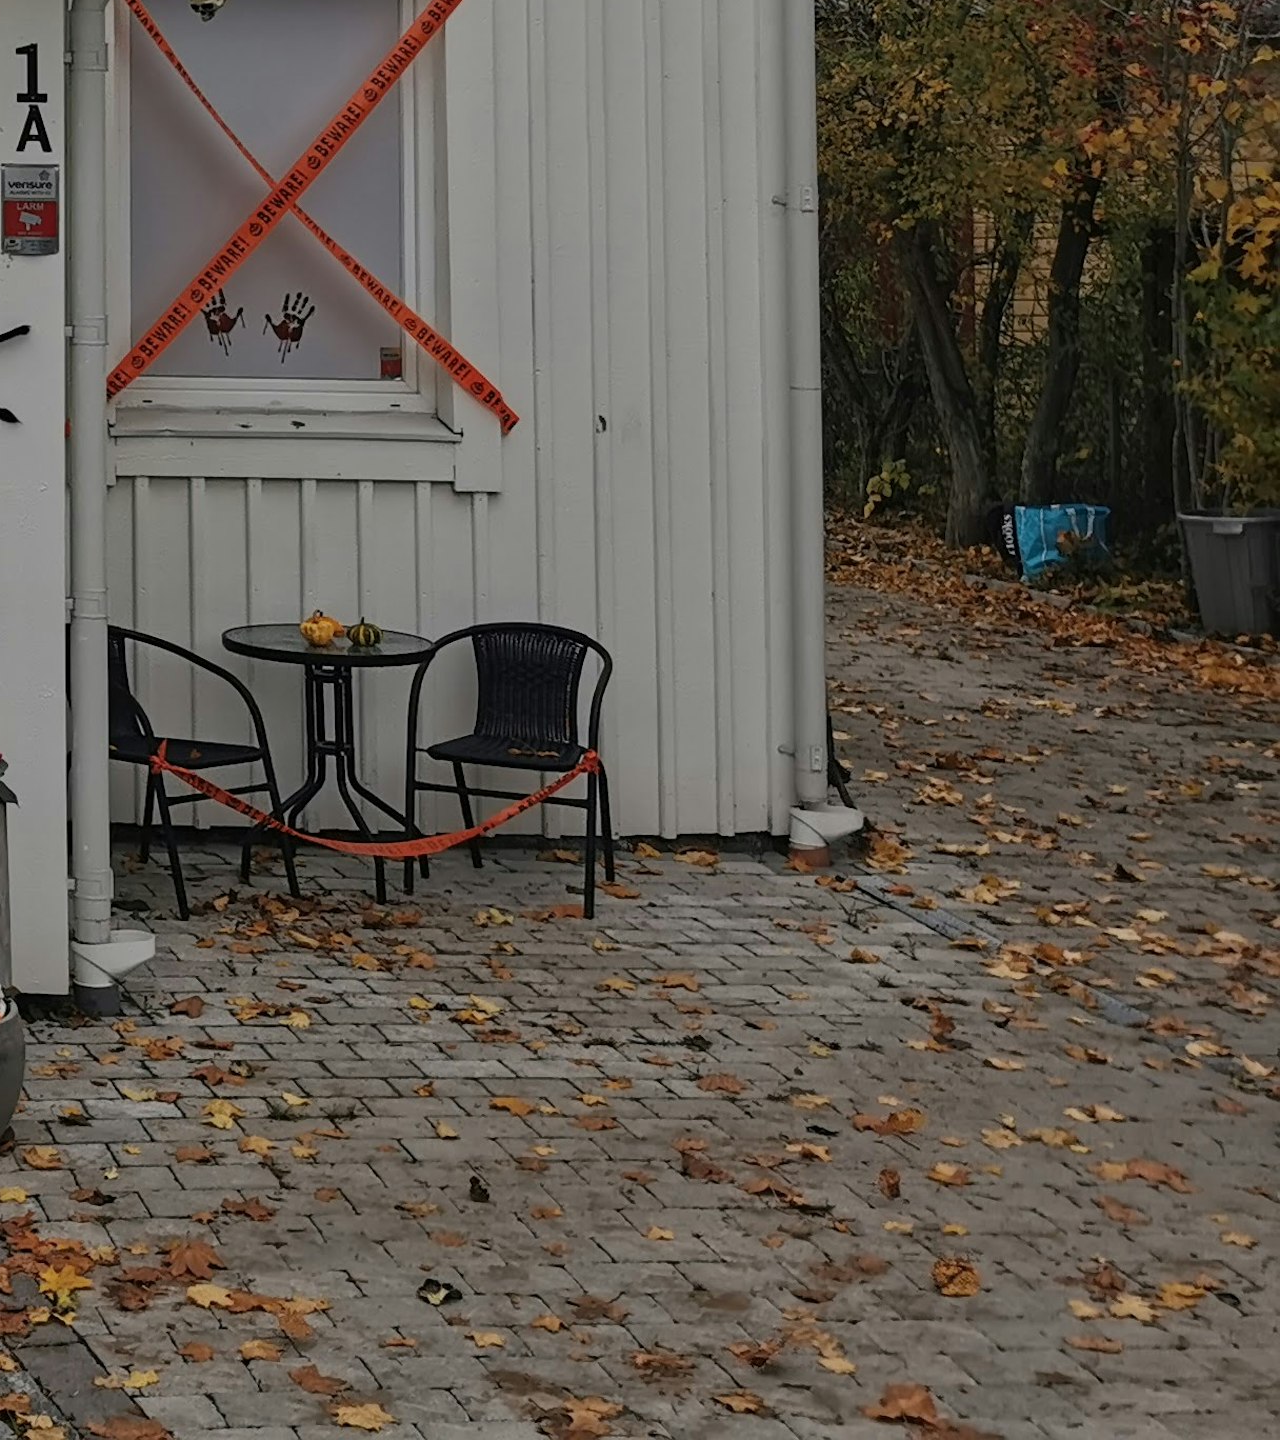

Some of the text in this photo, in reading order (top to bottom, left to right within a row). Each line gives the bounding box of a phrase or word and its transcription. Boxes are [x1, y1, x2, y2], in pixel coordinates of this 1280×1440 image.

[138, 303, 192, 357] BEWARE!
[197, 235, 251, 292] BEWARE!
[256, 168, 308, 225] BEWARE!
[314, 101, 365, 158] BEWARE!
[370, 34, 421, 90] BEWARE!
[352, 263, 403, 317] BEWARE!
[416, 327, 472, 381] BEWARE!
